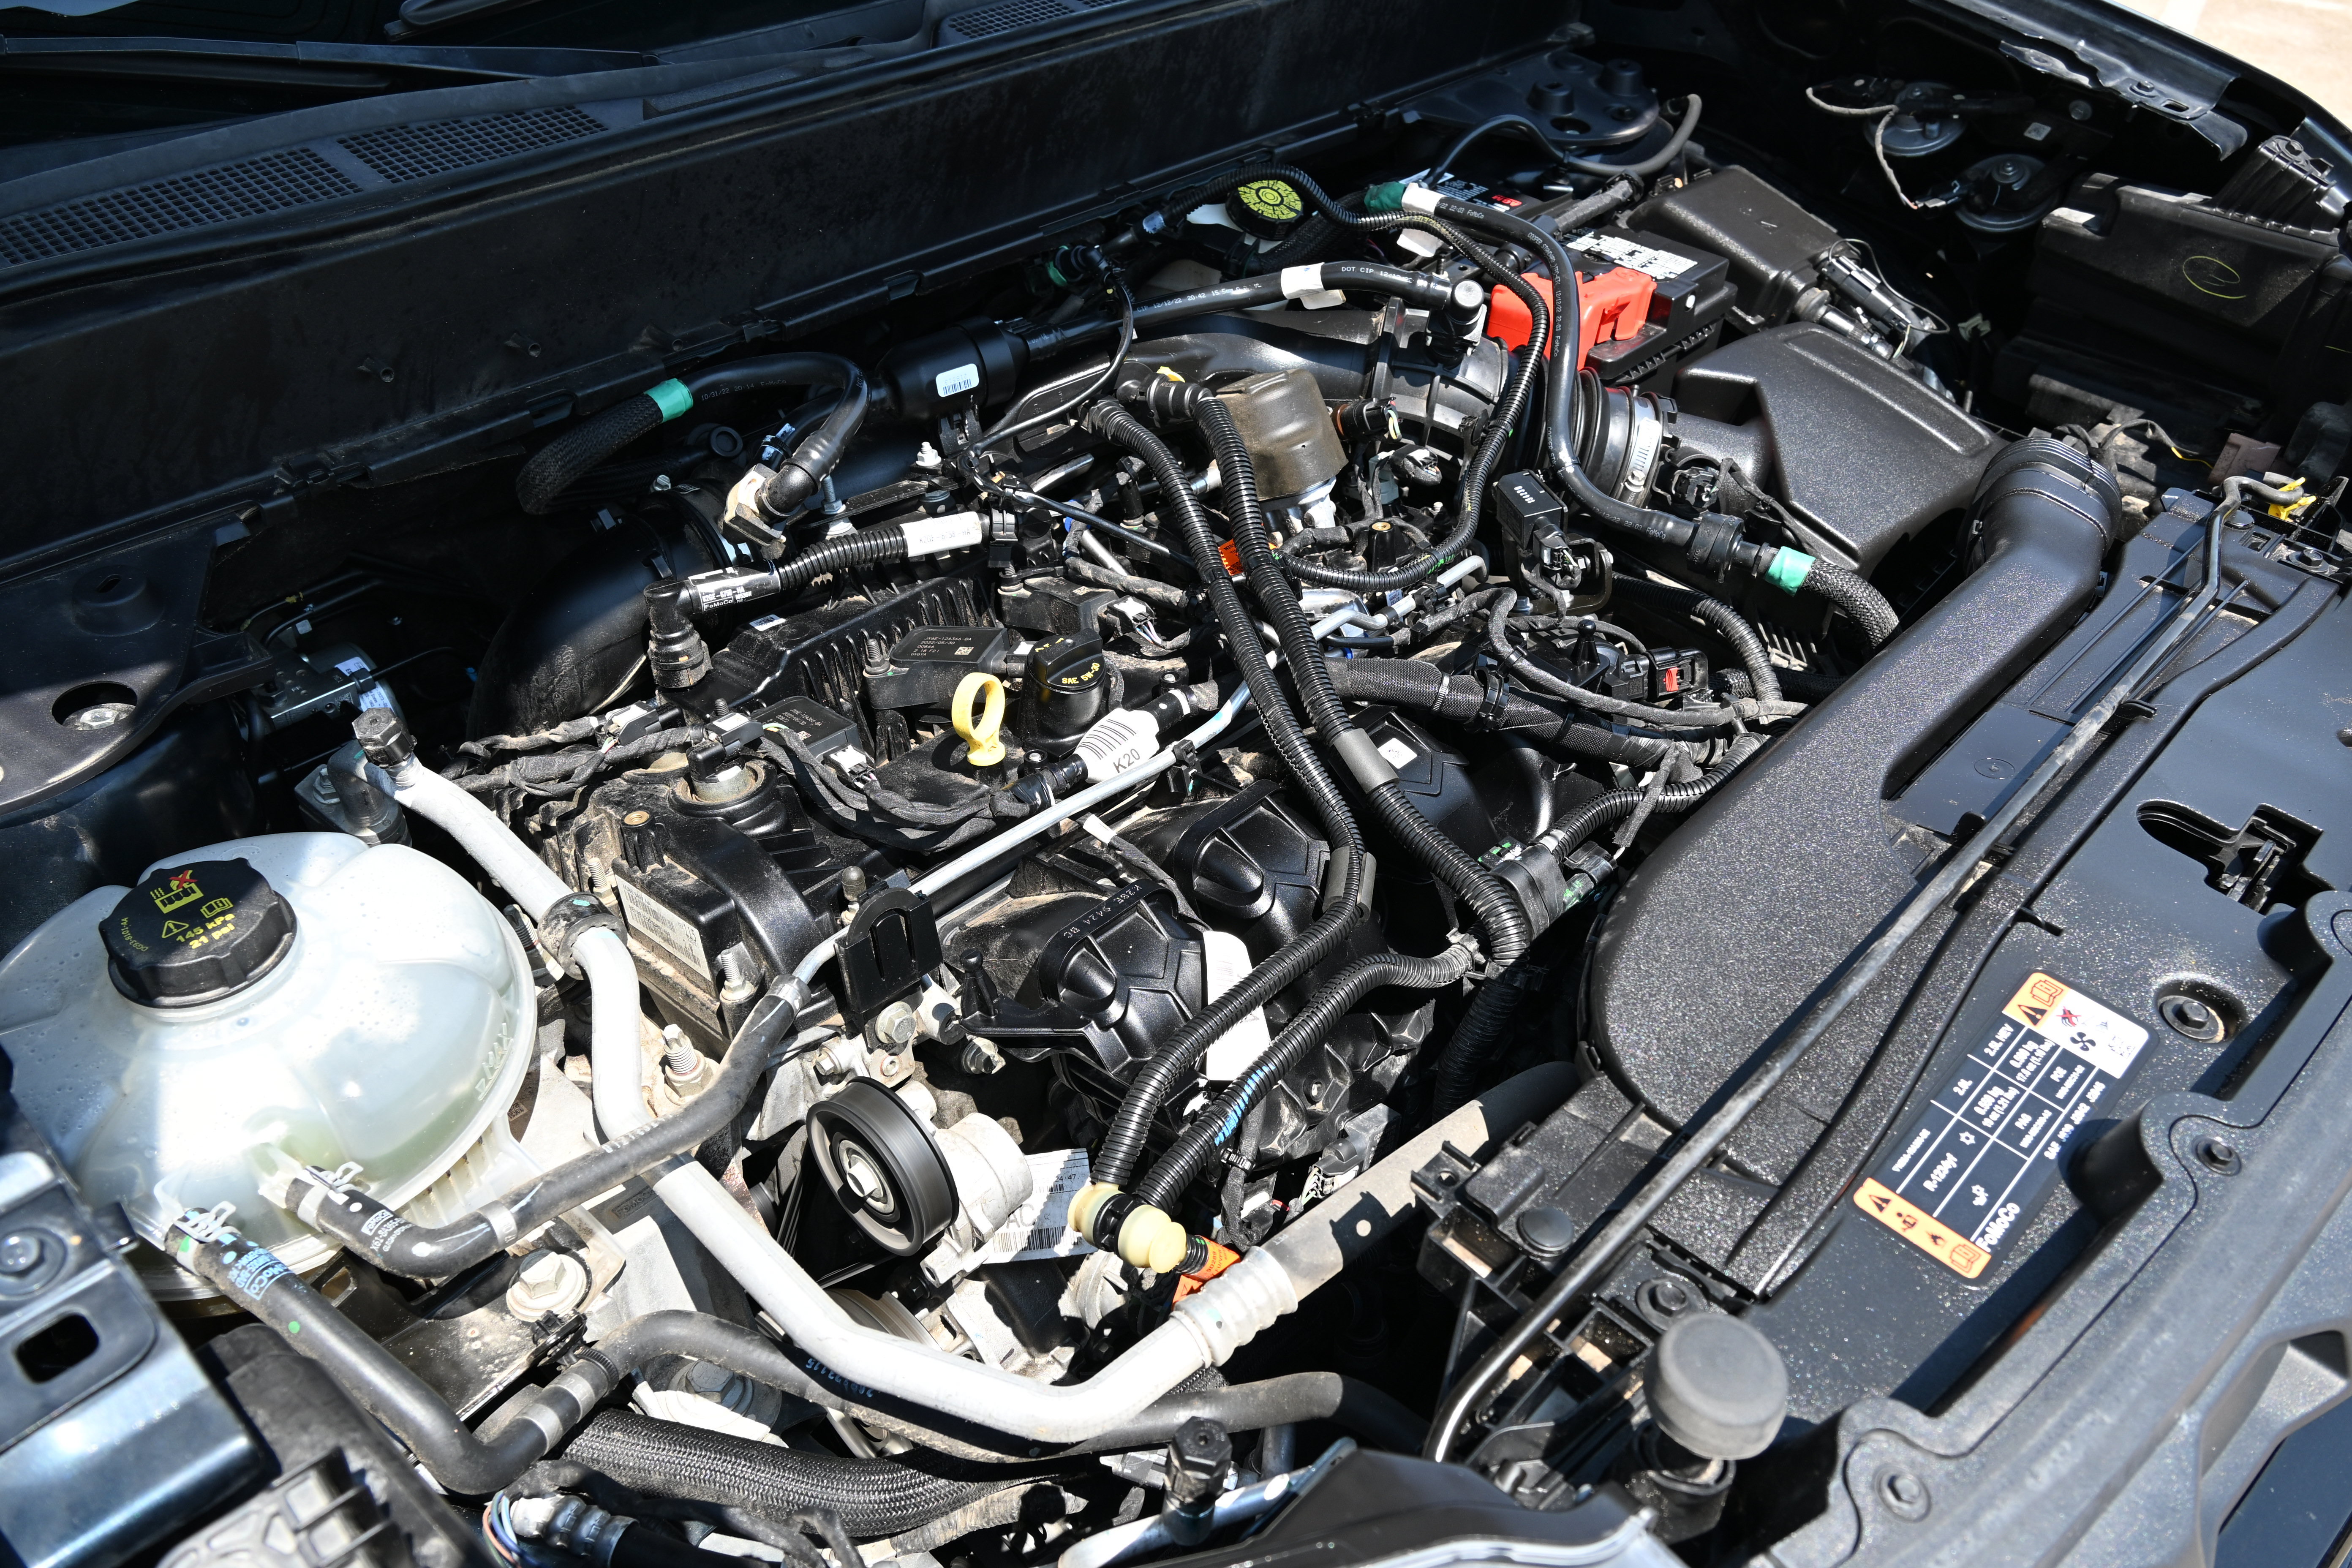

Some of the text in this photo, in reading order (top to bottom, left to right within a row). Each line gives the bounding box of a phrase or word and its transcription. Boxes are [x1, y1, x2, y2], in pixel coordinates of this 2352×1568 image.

[1153, 298, 1183, 310] 12/12/22
[1186, 293, 1207, 302] 20:42
[701, 387, 730, 401] 10/31/22
[734, 383, 755, 392] 20:14
[705, 599, 733, 610] FoMoCo
[1080, 662, 1100, 682] 5W-30
[1112, 748, 1142, 774] K20
[176, 913, 235, 942] 145 kPa
[189, 923, 235, 949] 21 psi
[1983, 1023, 2014, 1057] 2.5L HEV
[2050, 1066, 2067, 1082] POE
[1952, 1078, 1973, 1096] 2.0L
[2014, 1113, 2032, 1130] PAG
[1922, 1152, 1957, 1192] R-1234yf
[1975, 1202, 2020, 1252] FoMoCo
